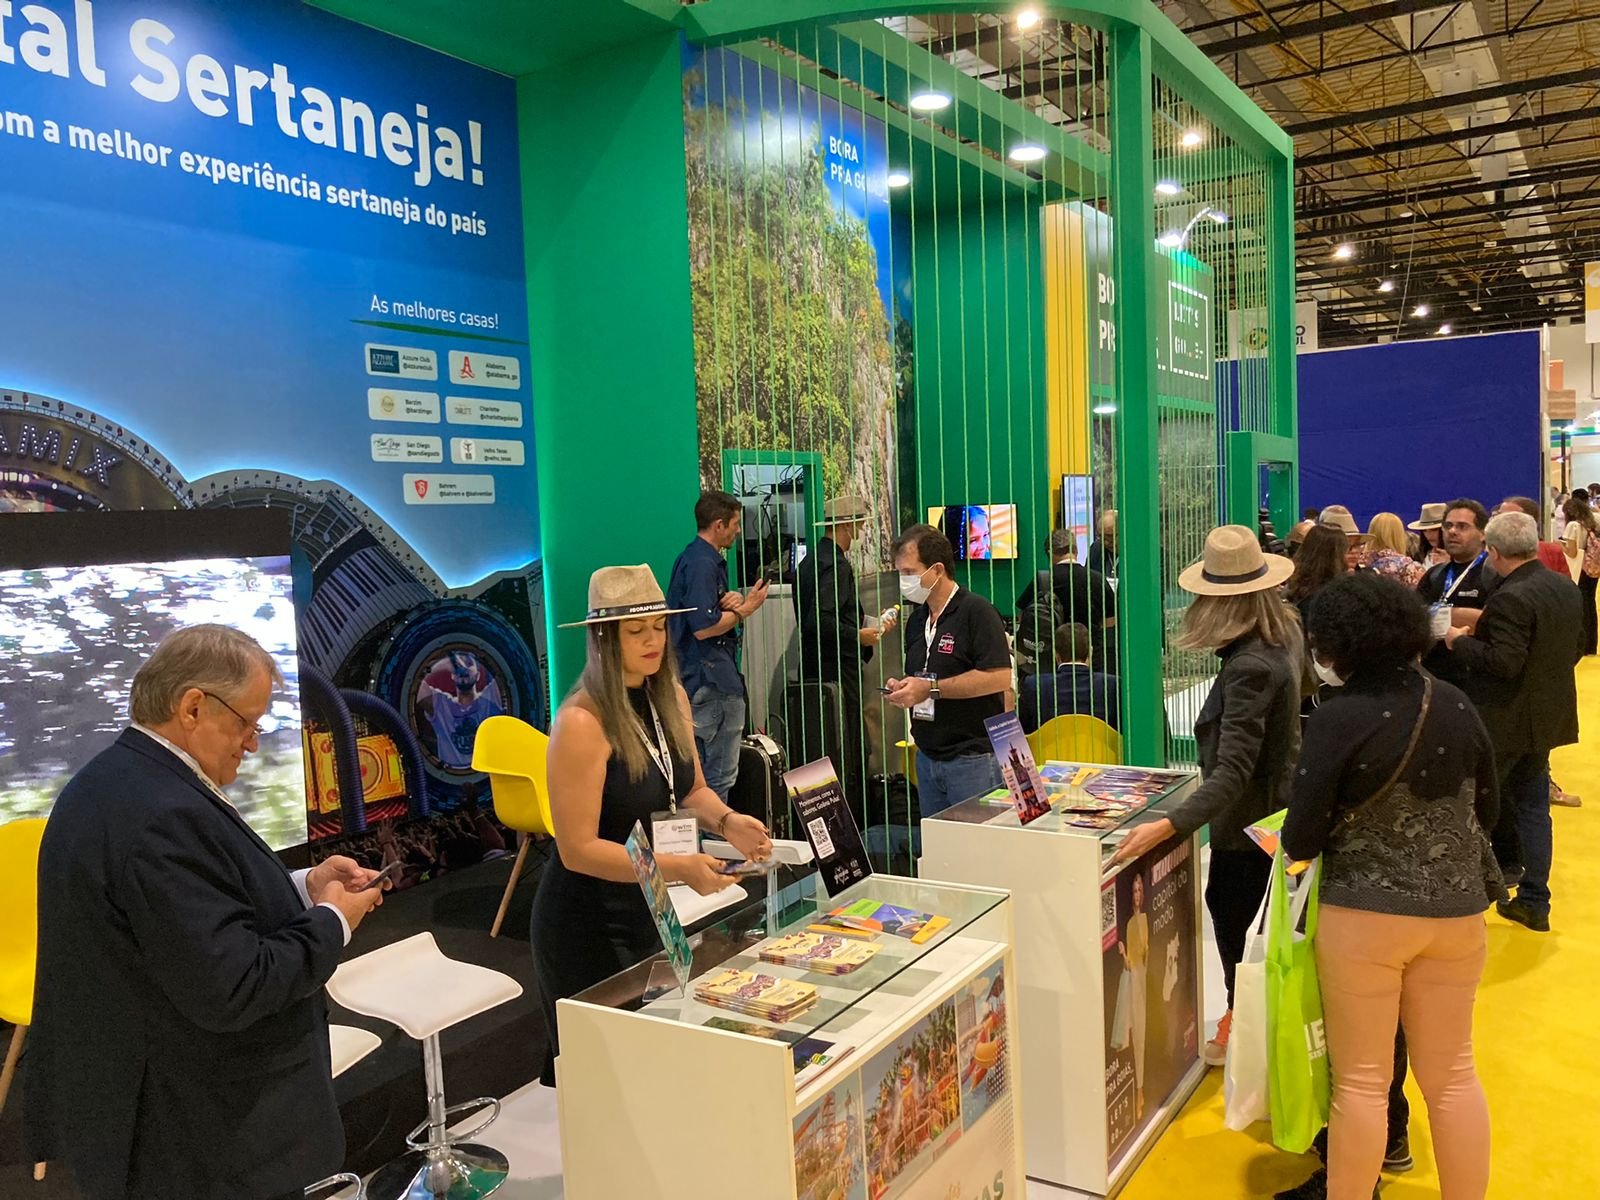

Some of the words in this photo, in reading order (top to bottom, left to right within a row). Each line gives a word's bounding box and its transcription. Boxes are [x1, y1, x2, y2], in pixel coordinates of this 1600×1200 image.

[129, 17, 484, 187] Sertaneja!
[0, 110, 35, 138] m
[43, 119, 60, 144] a
[68, 123, 173, 167] melhor
[180, 150, 321, 201] experiência
[326, 184, 421, 225] sertaneja
[425, 203, 447, 228] do
[451, 211, 487, 236] país
[370, 294, 389, 313] As
[393, 300, 456, 323] melhores
[459, 312, 499, 330] casas!
